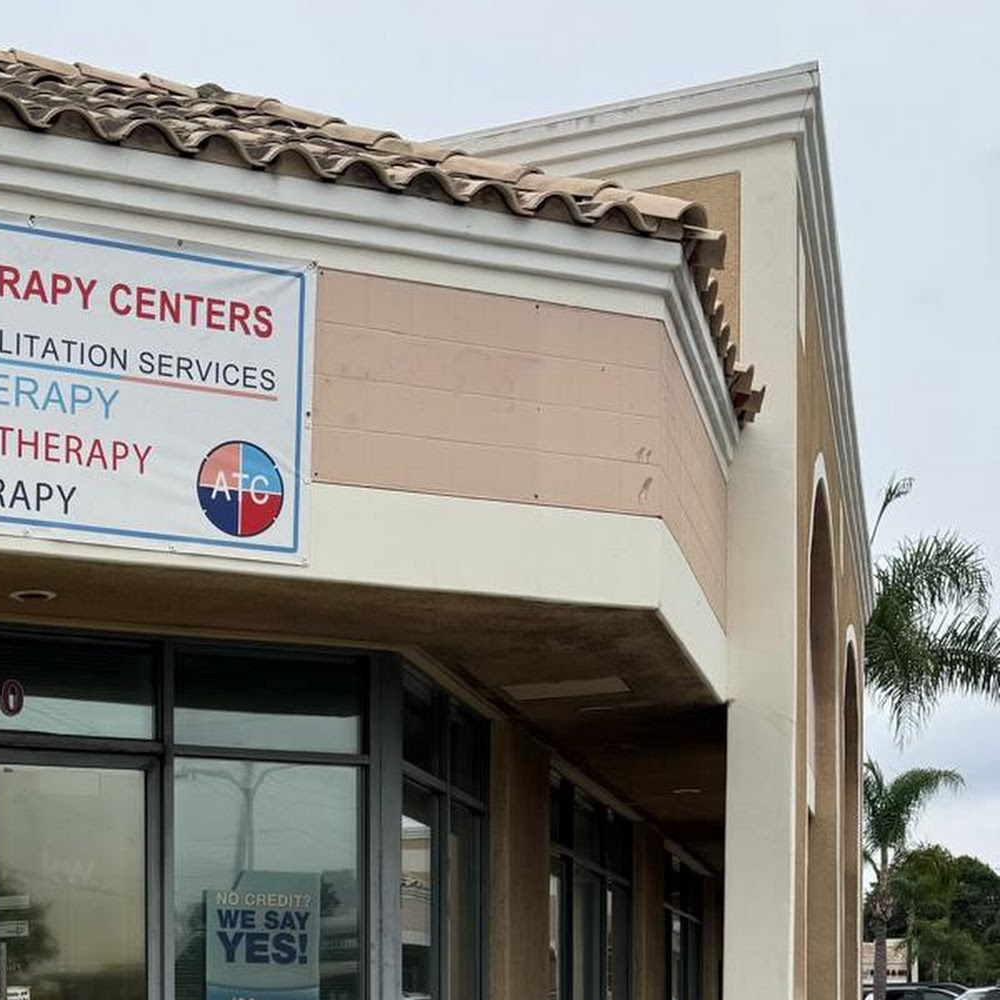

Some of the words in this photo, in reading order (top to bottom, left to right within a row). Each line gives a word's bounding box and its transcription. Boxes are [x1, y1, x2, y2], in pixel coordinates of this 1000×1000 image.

[109, 282, 273, 338] CENTERS
[138, 351, 276, 391] SERVICES
[210, 470, 270, 505] ATC
[216, 892, 239, 906] NO
[244, 892, 312, 908] CREDIT?
[216, 909, 256, 929] WE
[264, 910, 309, 930] SAY
[217, 931, 308, 965] YES!
